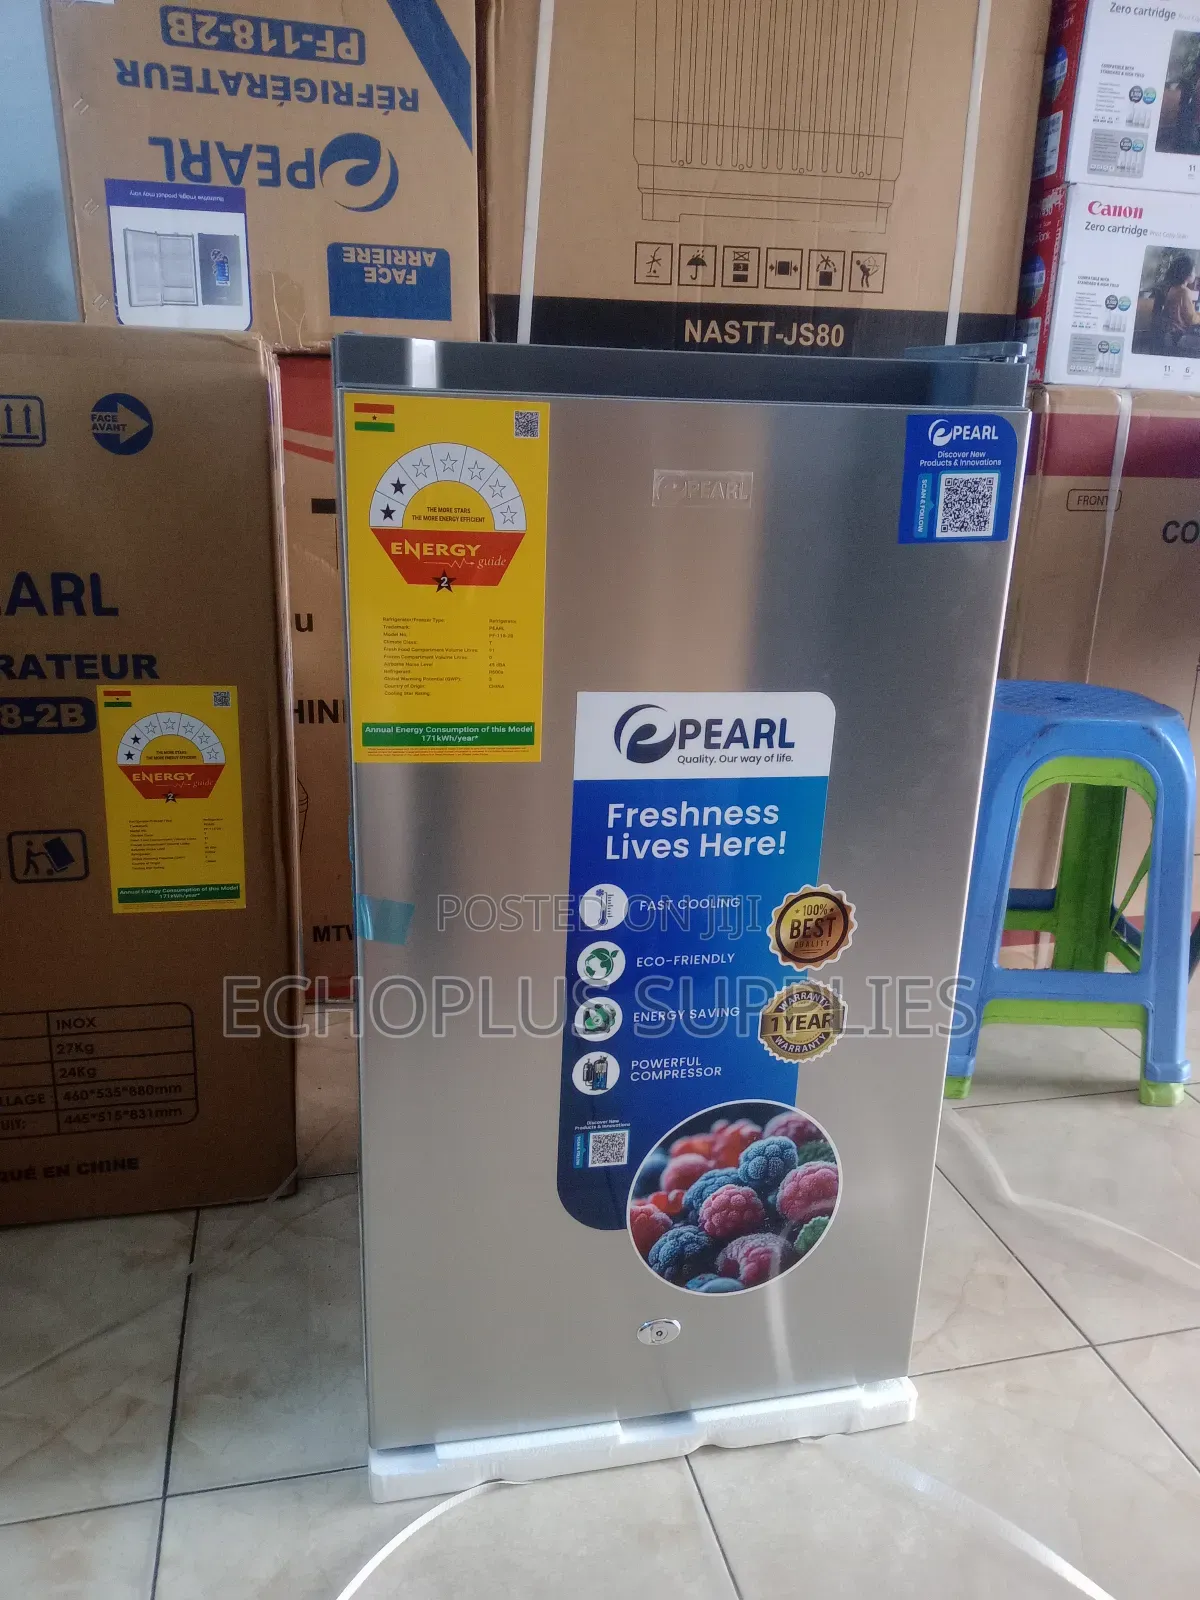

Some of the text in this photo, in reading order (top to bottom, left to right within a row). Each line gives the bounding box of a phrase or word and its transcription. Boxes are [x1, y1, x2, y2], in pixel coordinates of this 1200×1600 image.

[1110, 2, 1132, 15] Zero
[1133, 6, 1176, 22] cartridge
[167, 13, 360, 61] PF-118-2B
[113, 58, 420, 115] RÉFRIGÉRATEUR
[148, 136, 315, 190] PEARL
[1087, 200, 1144, 219] Canon
[1085, 222, 1105, 232] Zero
[1107, 223, 1148, 237] cartridge
[342, 247, 436, 268] ARRIÈRE
[364, 267, 417, 285] FACE
[684, 319, 845, 348] NASTT-JS80
[91, 414, 118, 423] FACE
[91, 423, 127, 432] AVANT
[953, 425, 999, 440] PEARL
[938, 450, 970, 458] Discover
[960, 458, 1002, 466] Innovations
[920, 479, 928, 498] SCAN
[918, 504, 926, 533] FOLLOW
[1162, 520, 1200, 544] CO
[390, 539, 482, 560] ENERGY
[477, 555, 508, 569] guide
[440, 576, 448, 586] 2
[395, 726, 424, 735] Energy
[425, 726, 480, 735] Consumption
[508, 725, 533, 733] Model
[678, 718, 796, 750] PEARL
[678, 754, 794, 766] Quality. Our way of life.
[132, 771, 195, 784] ENERGY
[607, 800, 779, 828] Freshness
[606, 830, 787, 860] Lives Here!
[141, 888, 161, 896] Energy
[162, 887, 200, 895] Consumption
[640, 898, 741, 912] FAST COOLING
[802, 904, 828, 916] 100%
[790, 917, 837, 940] BEST
[794, 940, 830, 949] QUALITY
[636, 953, 736, 968] ECO-FRIENDLY
[778, 991, 831, 1012] WARRANTY
[633, 1006, 740, 1023] ENERGY SAVING
[770, 1013, 835, 1032] 1 YEAR
[56, 1016, 96, 1030] INOX
[56, 1042, 94, 1056] 27Kg
[774, 1034, 828, 1054] WARRANTY
[631, 1056, 702, 1070] POWERFUL
[59, 1066, 96, 1080] 24Kg
[630, 1066, 722, 1082] COMPRESSOR
